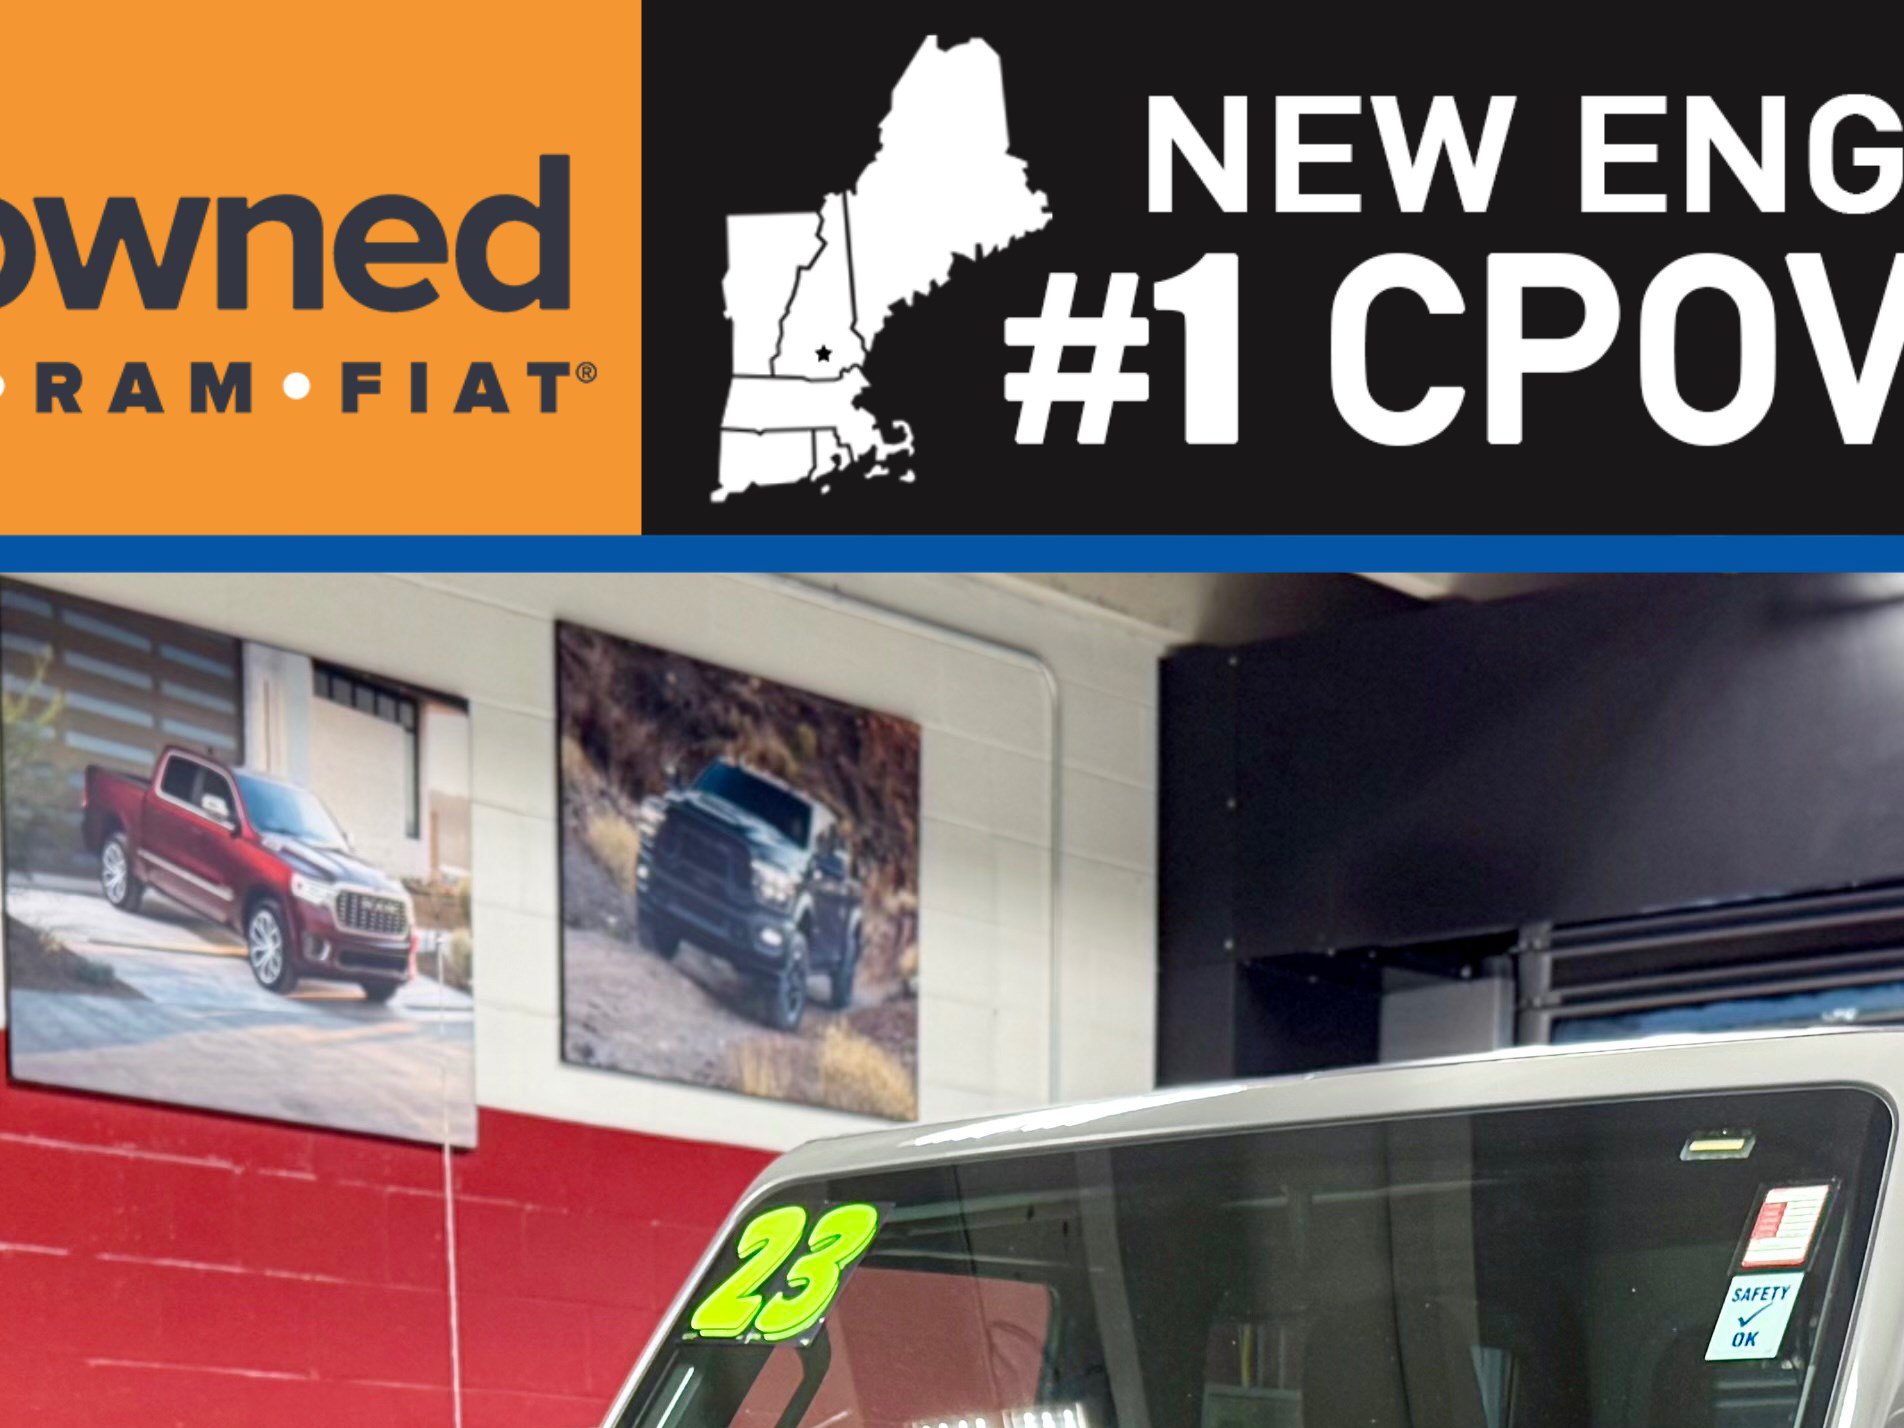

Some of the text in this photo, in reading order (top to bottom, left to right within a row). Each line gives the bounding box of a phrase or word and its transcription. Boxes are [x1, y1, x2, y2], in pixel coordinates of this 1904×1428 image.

[690, 1203, 879, 1341] 23
[1731, 1285, 1791, 1303] SAFETY
[1732, 1331, 1759, 1348] OK
